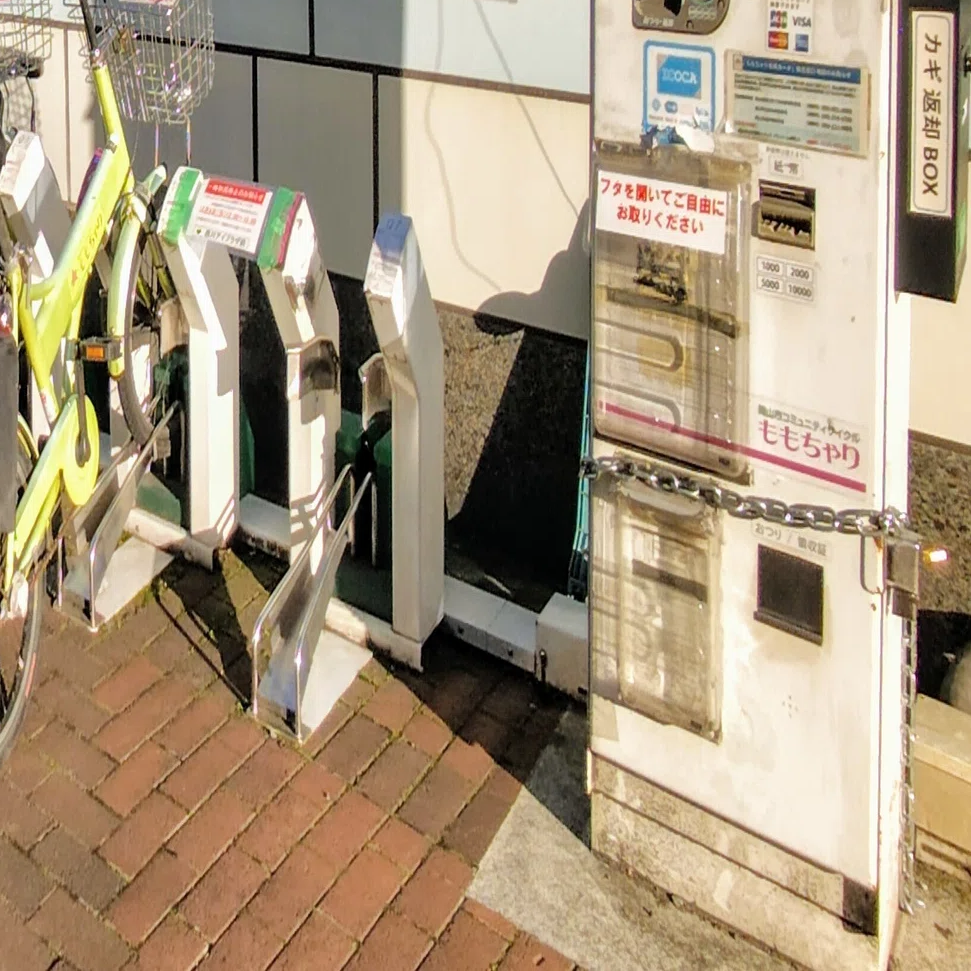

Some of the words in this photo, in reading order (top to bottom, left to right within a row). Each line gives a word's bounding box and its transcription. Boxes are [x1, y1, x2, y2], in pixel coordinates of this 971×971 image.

[792, 15, 812, 28] VISA
[600, 177, 725, 217] フタを開いてご自由に
[616, 204, 704, 235] お取りください
[761, 260, 780, 273] 1000
[790, 267, 810, 280] 2000
[761, 278, 780, 291] 5000
[788, 284, 812, 298] 10000
[758, 419, 860, 470] ももちゃり
[755, 522, 782, 541] おつり
